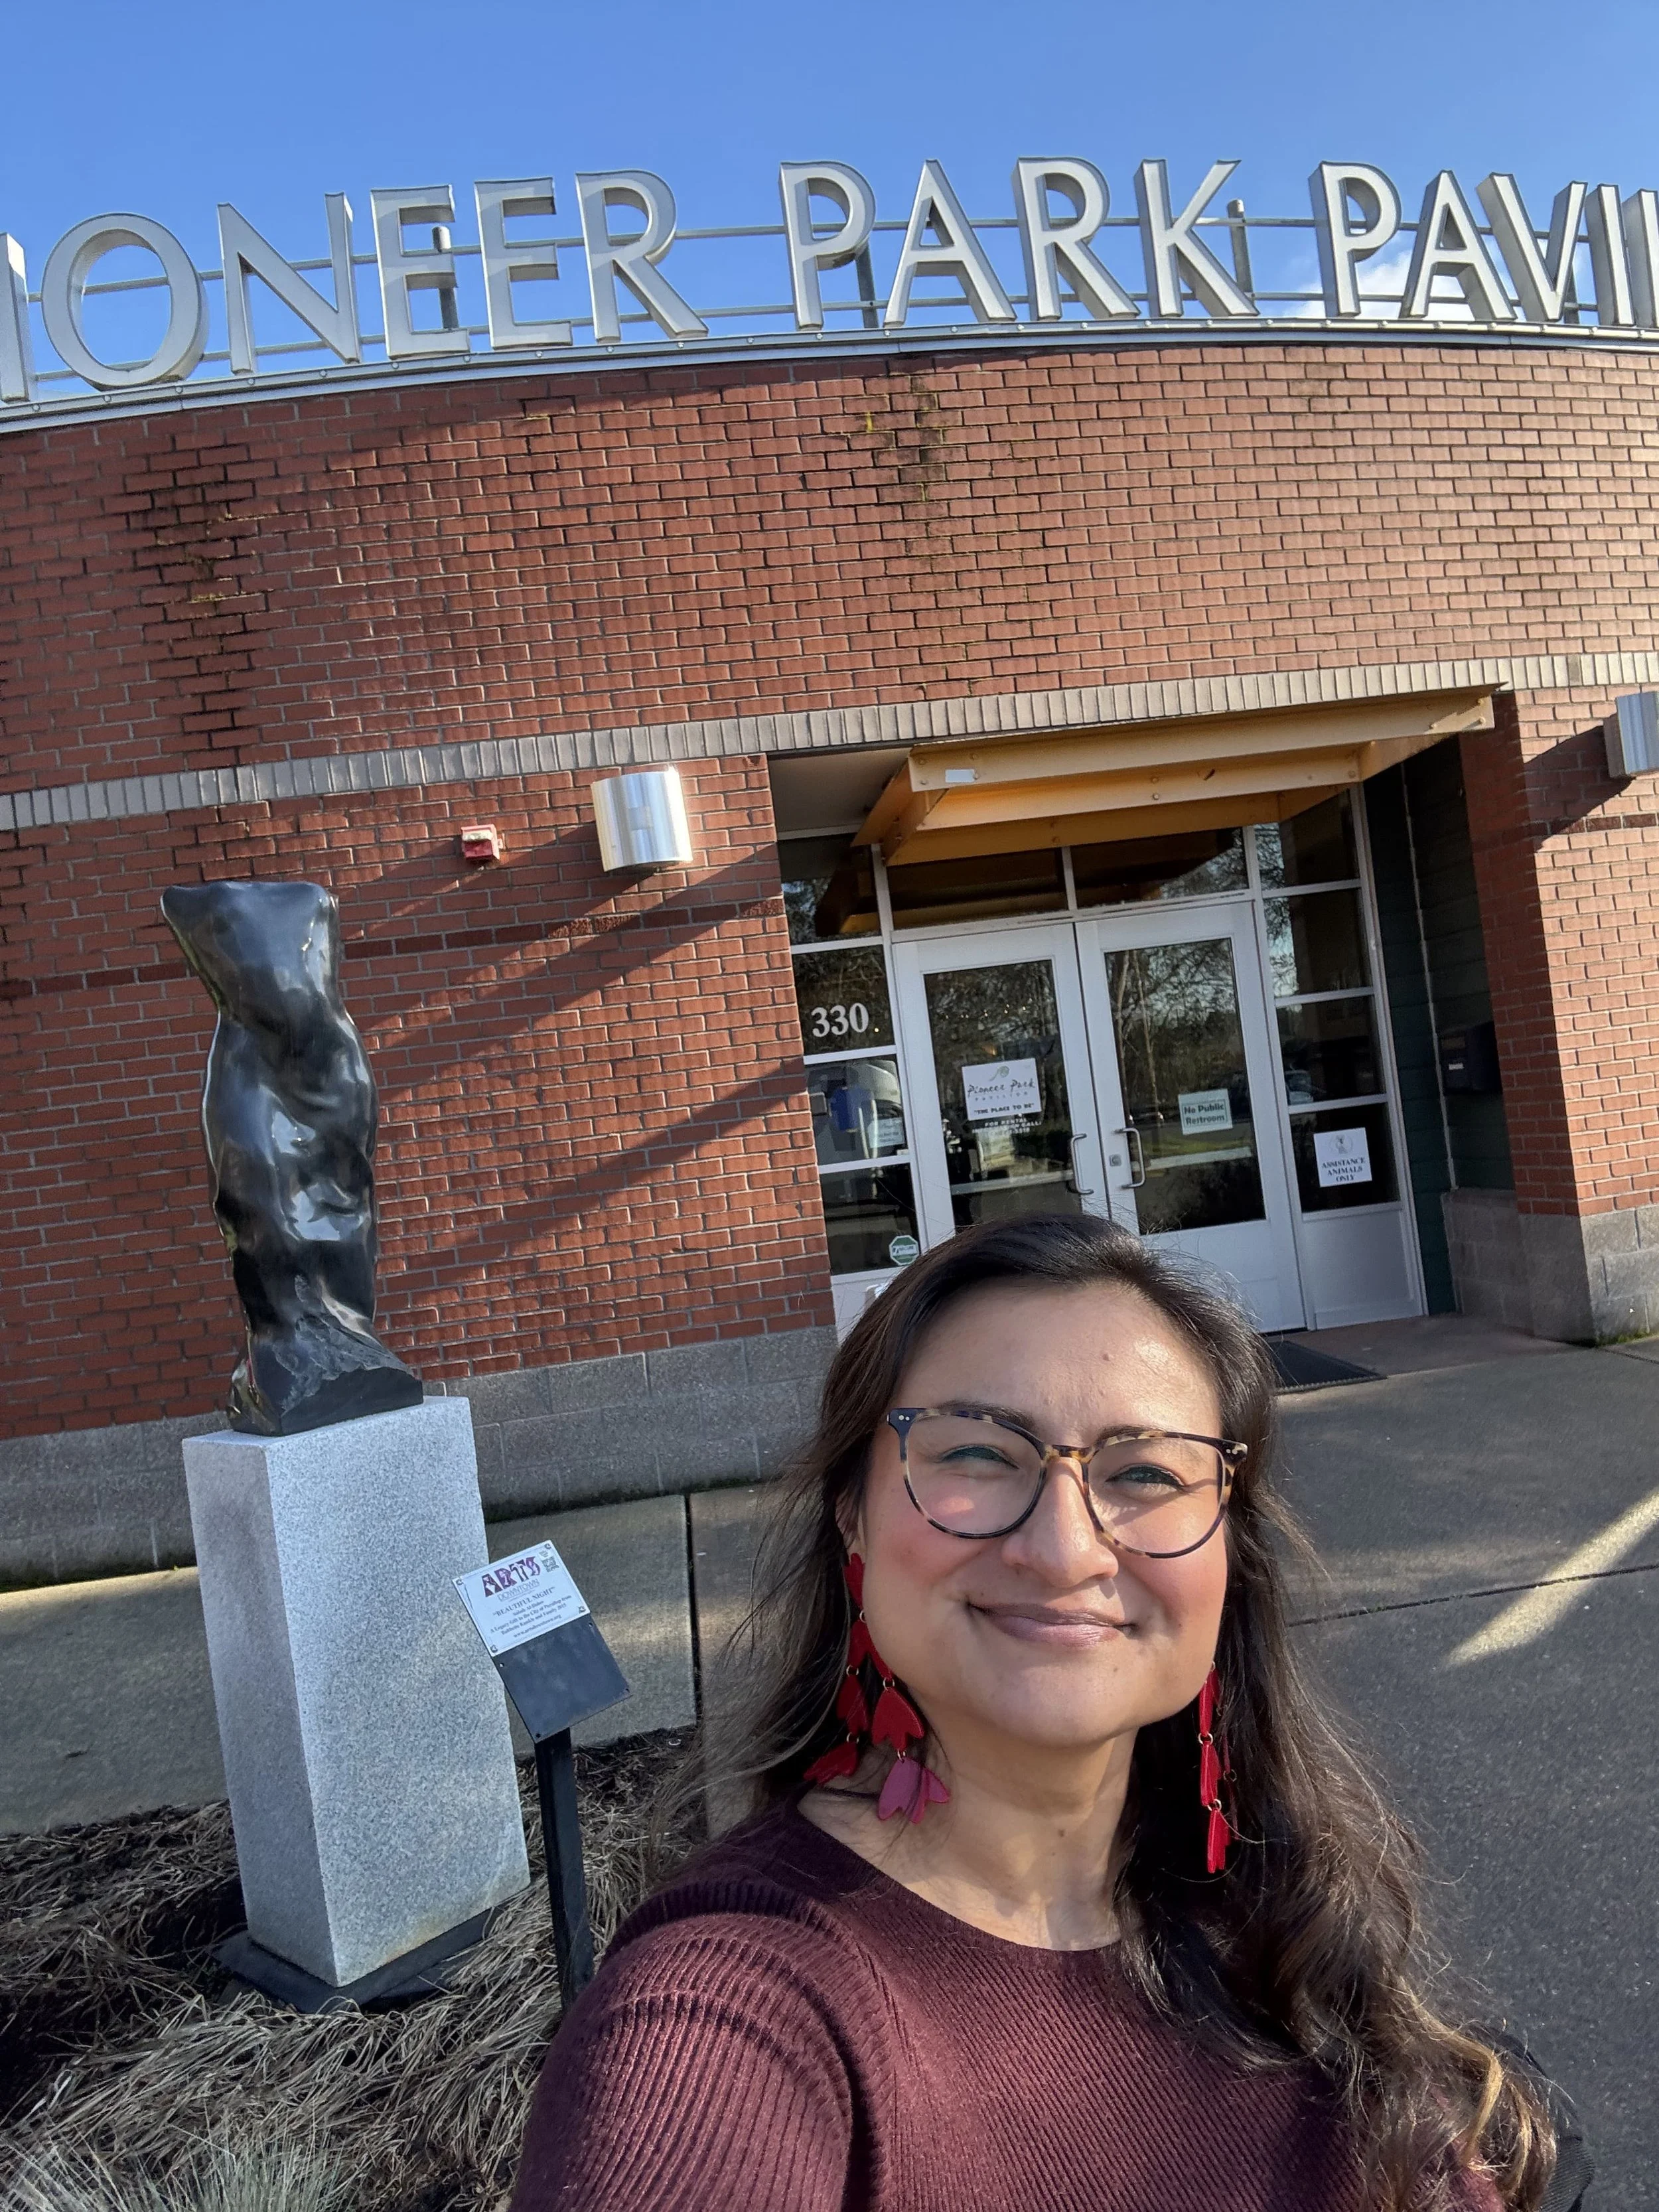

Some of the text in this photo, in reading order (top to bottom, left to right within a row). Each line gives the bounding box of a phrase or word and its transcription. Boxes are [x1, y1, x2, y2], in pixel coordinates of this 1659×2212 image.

[778, 157, 1260, 330] PARK
[811, 1002, 869, 1037] 330
[968, 1078, 1035, 1097] Pioneer Park
[1198, 1103, 1224, 1112] Public
[1322, 1157, 1366, 1168] ASSISTANCE
[1328, 1165, 1363, 1176] ANIMALS
[481, 1556, 541, 1597] ARTS
[498, 1578, 540, 1601] DOWNTOWN
